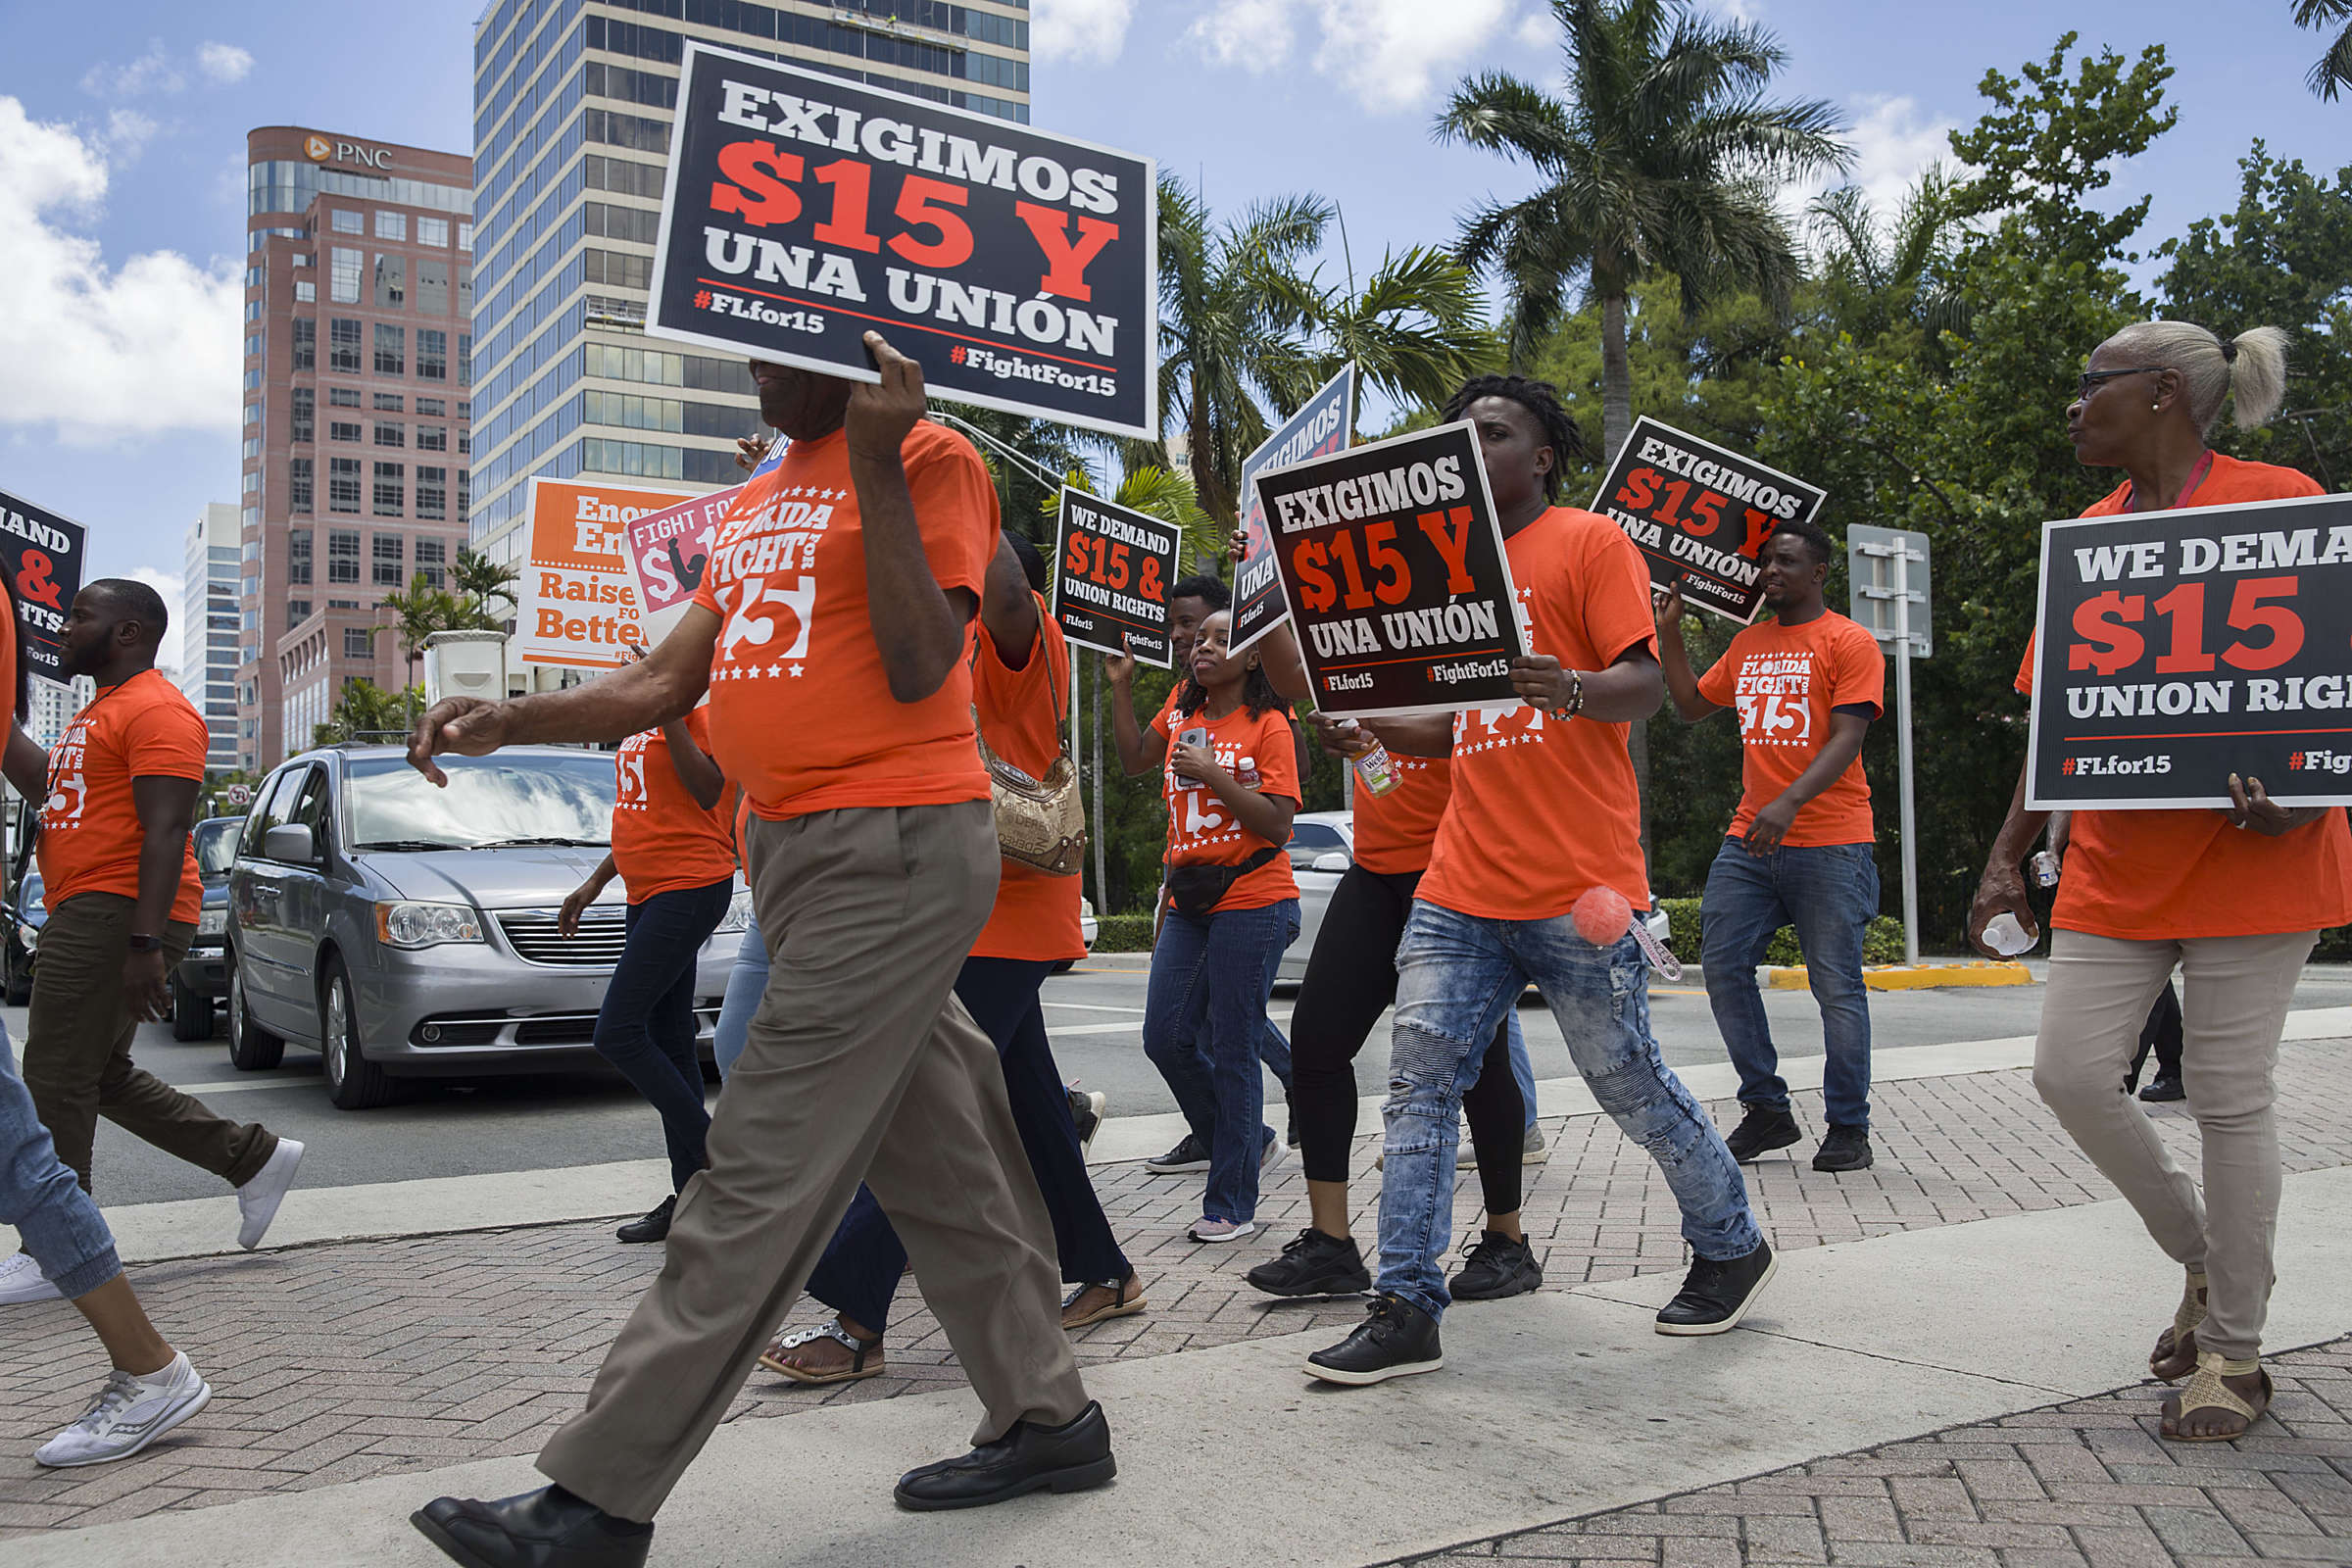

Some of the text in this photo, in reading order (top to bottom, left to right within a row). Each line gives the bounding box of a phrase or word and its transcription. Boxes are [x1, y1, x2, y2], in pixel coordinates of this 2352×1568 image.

[335, 141, 393, 171] PNC
[717, 79, 1118, 214] EXIGIMOS
[710, 139, 1119, 302] $15 Y
[694, 289, 825, 334] #FLfor15
[704, 226, 1118, 358] UNA UNIÓN
[951, 345, 1117, 397] #FightFor15
[1273, 455, 1466, 534] EXIGIMOS
[1636, 436, 1802, 519] EXIGIMOS
[633, 510, 697, 548] FIGHT
[715, 502, 834, 547] FLRIDA
[1070, 505, 1170, 556] WE DEMAND
[1615, 467, 1780, 560] $15 Y
[710, 531, 810, 589] FIGHT
[801, 533, 822, 570] FOR
[1065, 530, 1165, 603] $15 &
[1293, 520, 1413, 613] $15
[1416, 506, 1477, 595] Y
[1606, 507, 1762, 587] UNA UNIÓN
[2074, 525, 2352, 583] WE DEMA
[16, 549, 64, 611] &
[538, 571, 636, 606] Raise
[1064, 576, 1165, 623] UNION RIGHTS
[1241, 556, 1275, 602] UNA
[1681, 571, 1745, 605] #FightFor15
[617, 607, 640, 620] FO
[1062, 612, 1094, 631] #FLfor15
[1236, 602, 1265, 631] #FLfor15
[1308, 617, 1382, 659] UNA
[1381, 595, 1499, 654] UNIÓN
[2068, 575, 2305, 676] $15
[1121, 630, 1163, 651] #FightFor15
[1323, 672, 1374, 692] #FLfor15
[1426, 659, 1509, 685] #FightFor15
[1735, 675, 1802, 695] FIGHT
[1801, 675, 1810, 695] FOR
[1735, 696, 1810, 738] $15
[2066, 674, 2352, 719] UNION RIG
[2062, 755, 2172, 776] #FLfor15
